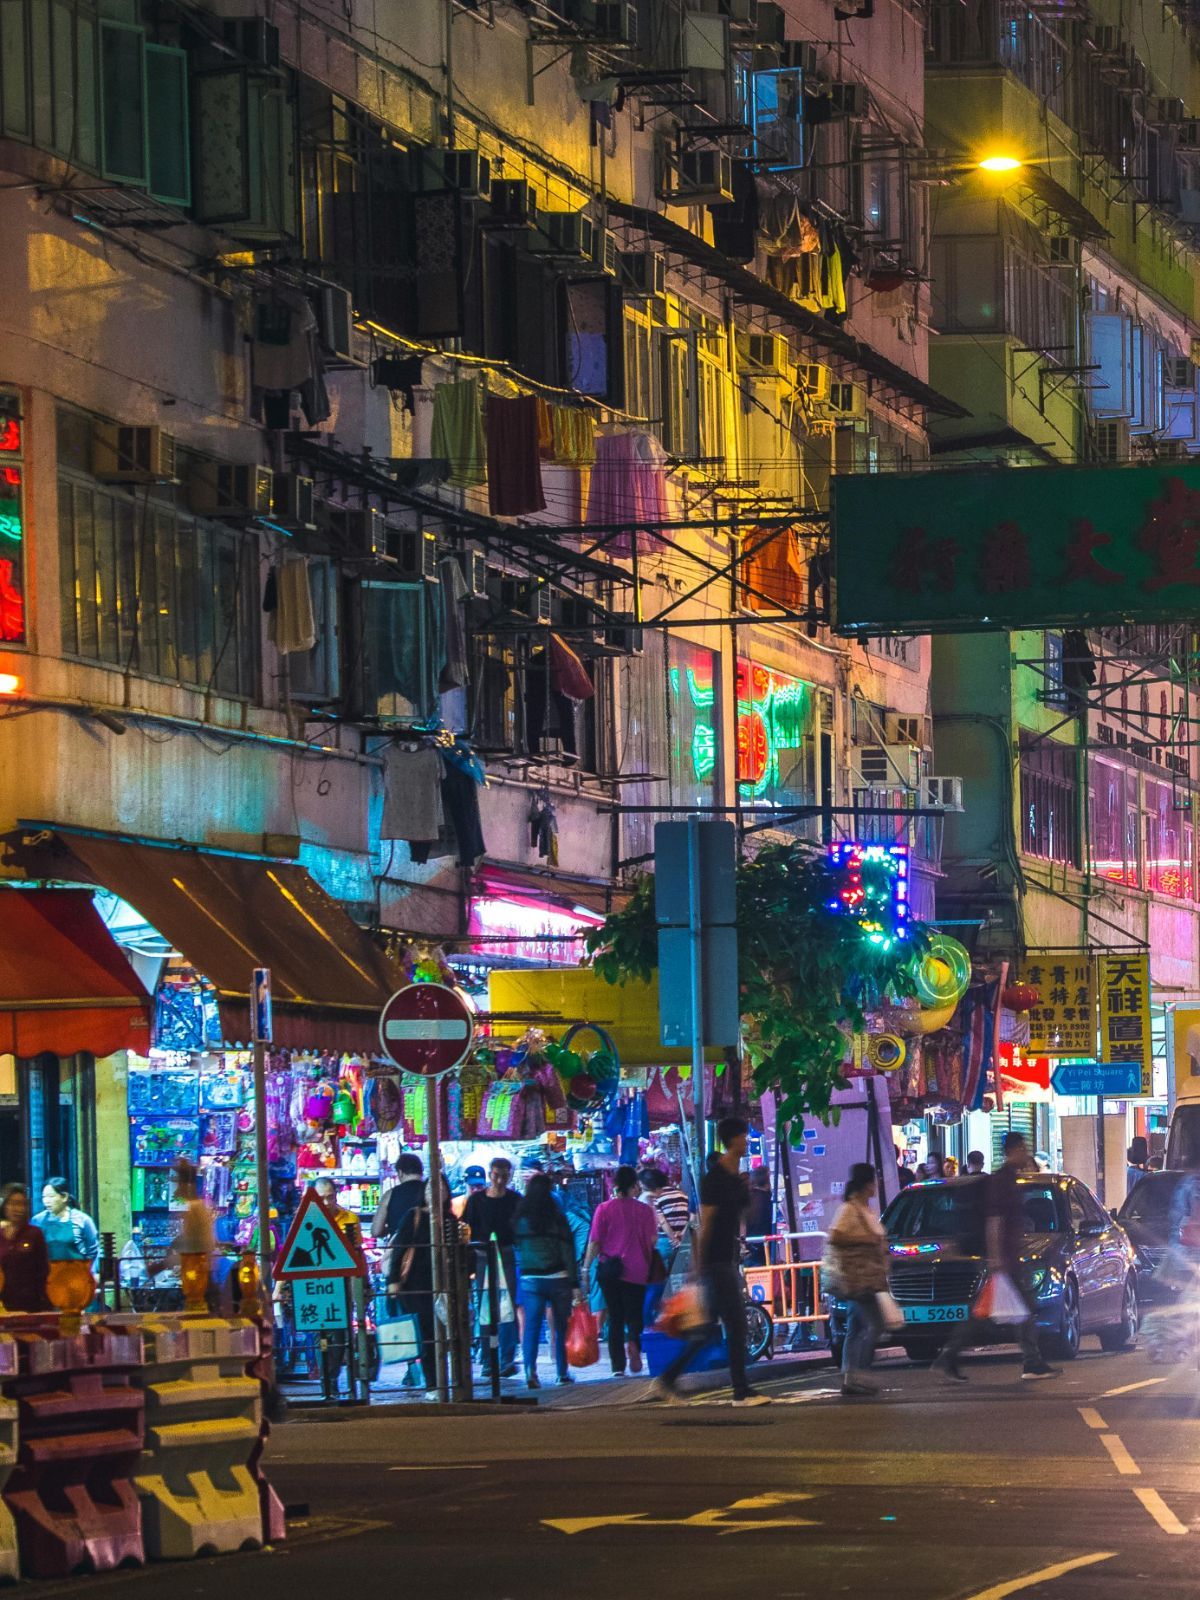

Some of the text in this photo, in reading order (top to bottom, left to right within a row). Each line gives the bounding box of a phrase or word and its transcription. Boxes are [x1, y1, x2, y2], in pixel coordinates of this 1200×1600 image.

[1036, 986, 1091, 1006] 特產
[1094, 1068, 1124, 1079] Square
[305, 1281, 334, 1296] End
[300, 1302, 343, 1324] 終止
[927, 1307, 965, 1321] 5268
